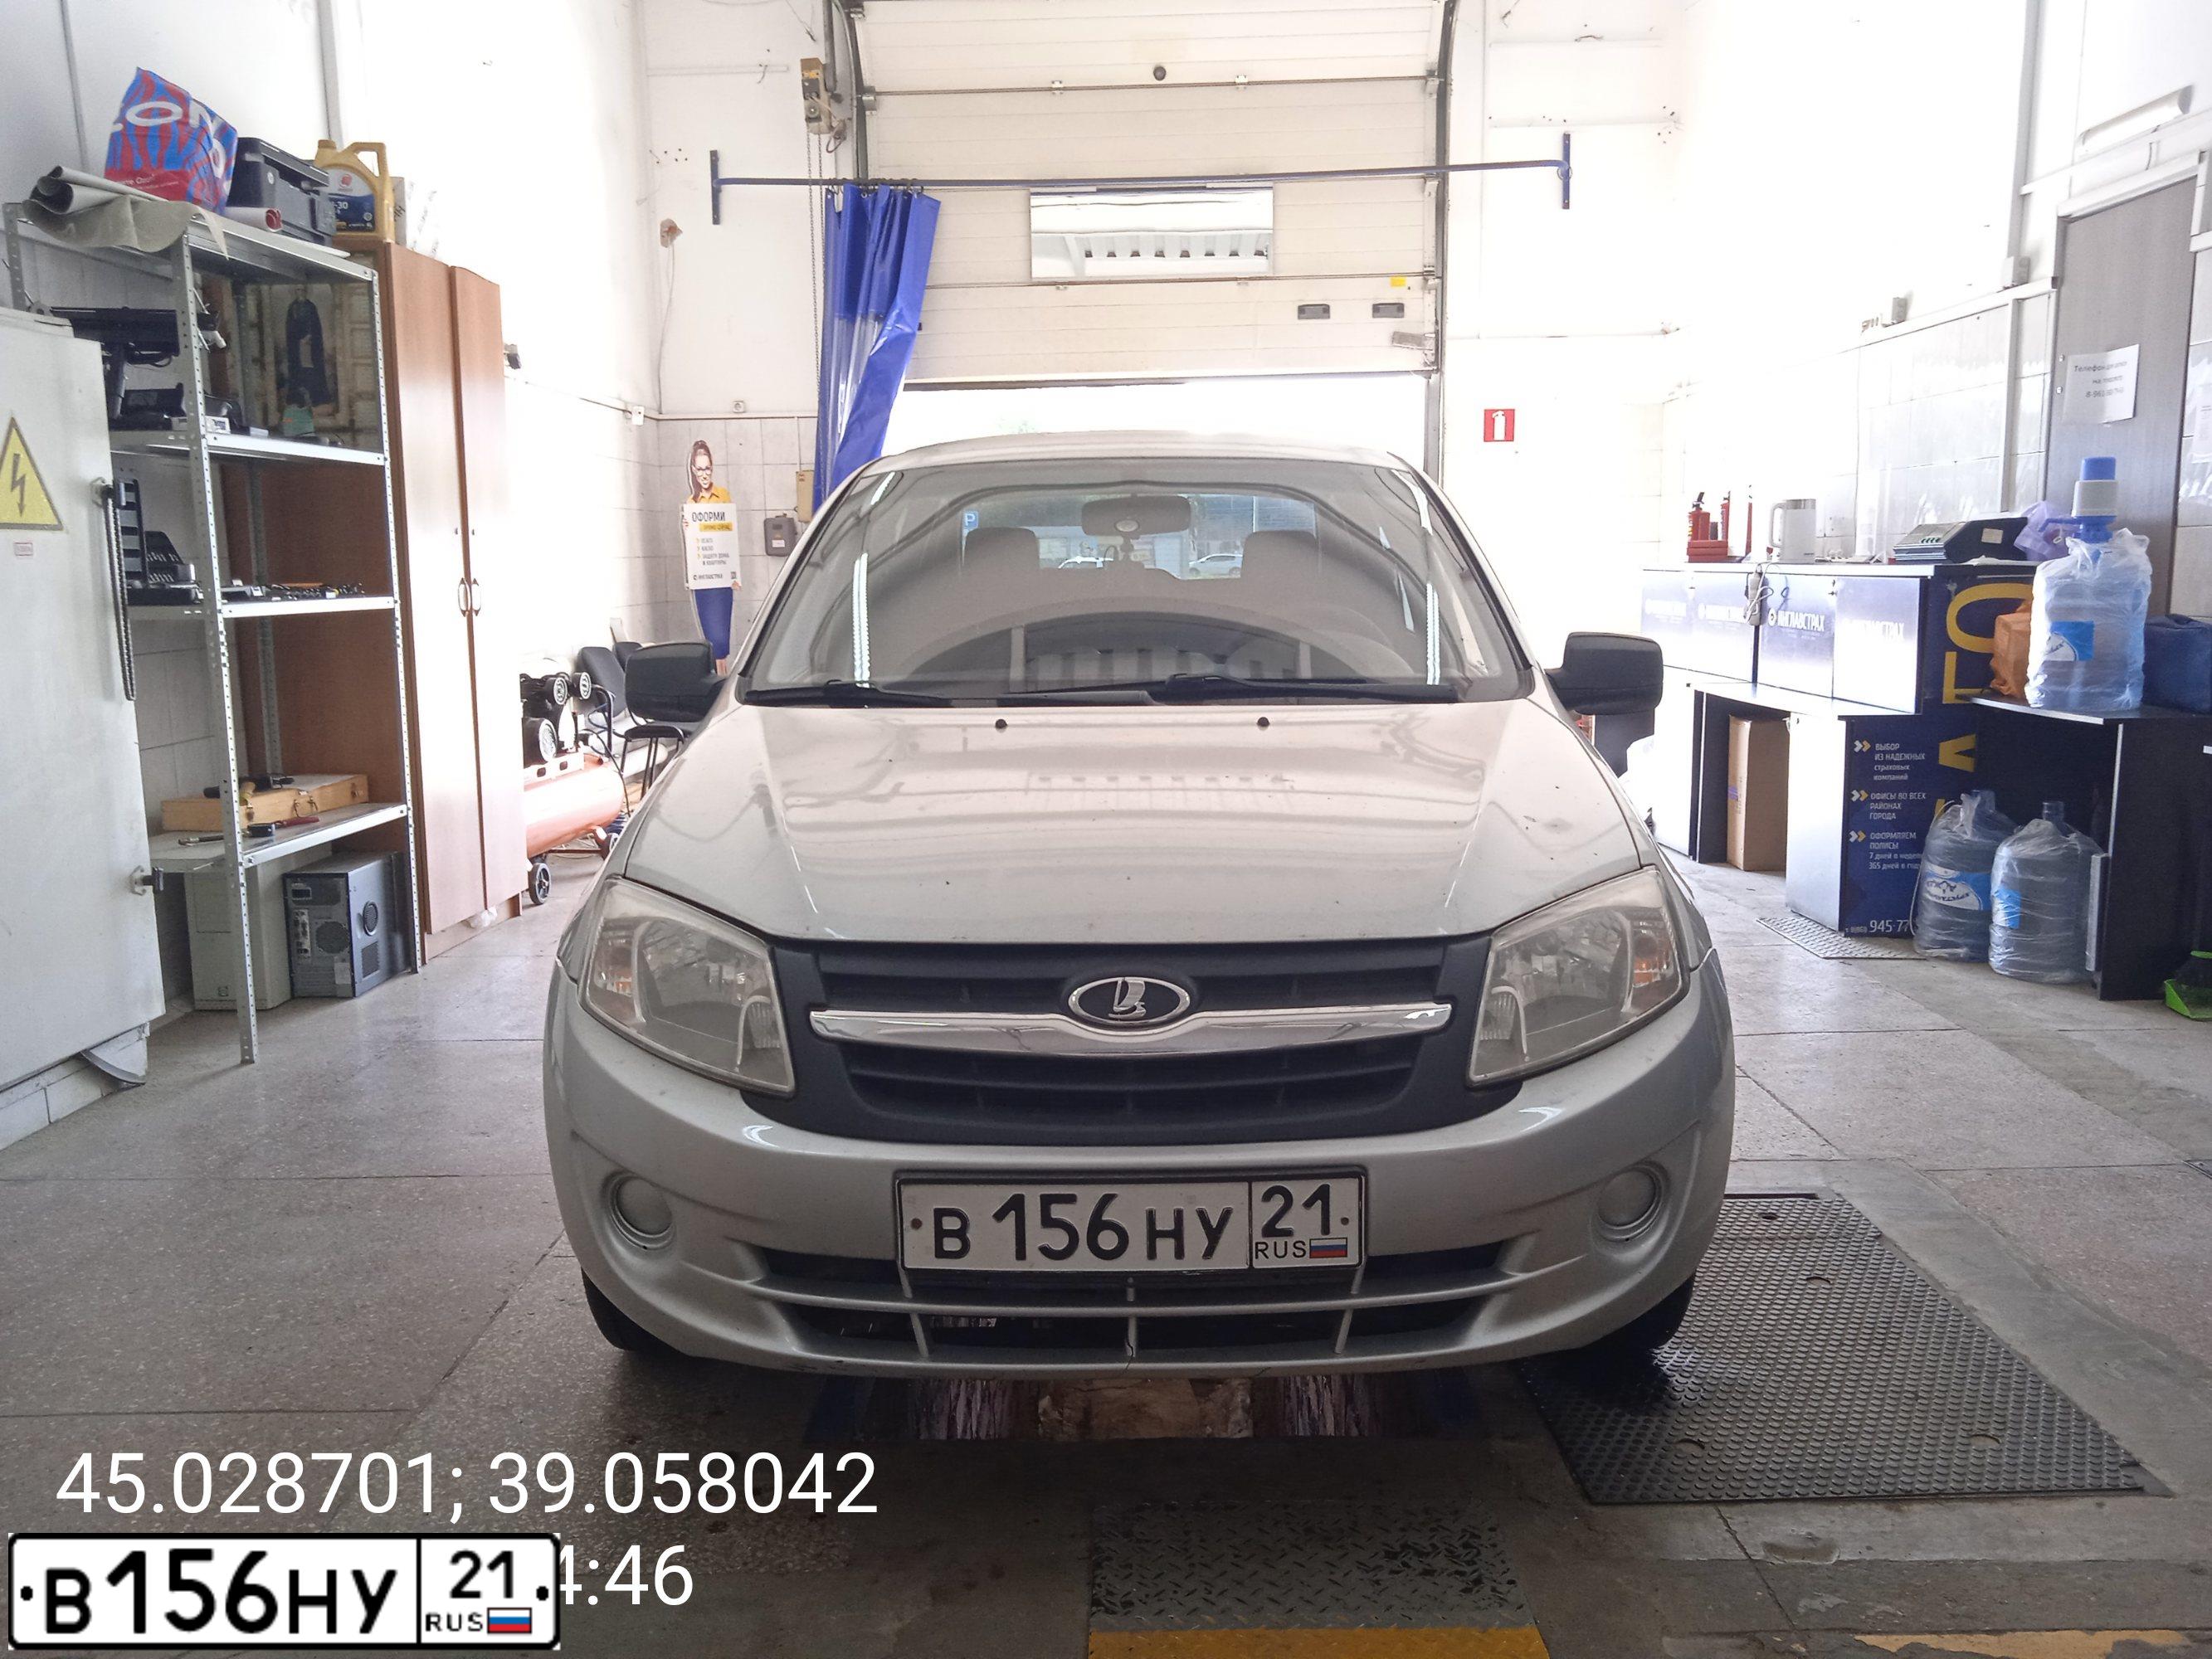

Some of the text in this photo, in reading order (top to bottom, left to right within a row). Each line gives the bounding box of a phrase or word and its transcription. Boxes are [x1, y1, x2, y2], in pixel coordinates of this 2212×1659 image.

[692, 512, 725, 522] ОФОРМИ
[1869, 812, 1896, 820] ГОРОДА
[1261, 1184, 1331, 1238] 21
[1255, 1240, 1307, 1259] RUS
